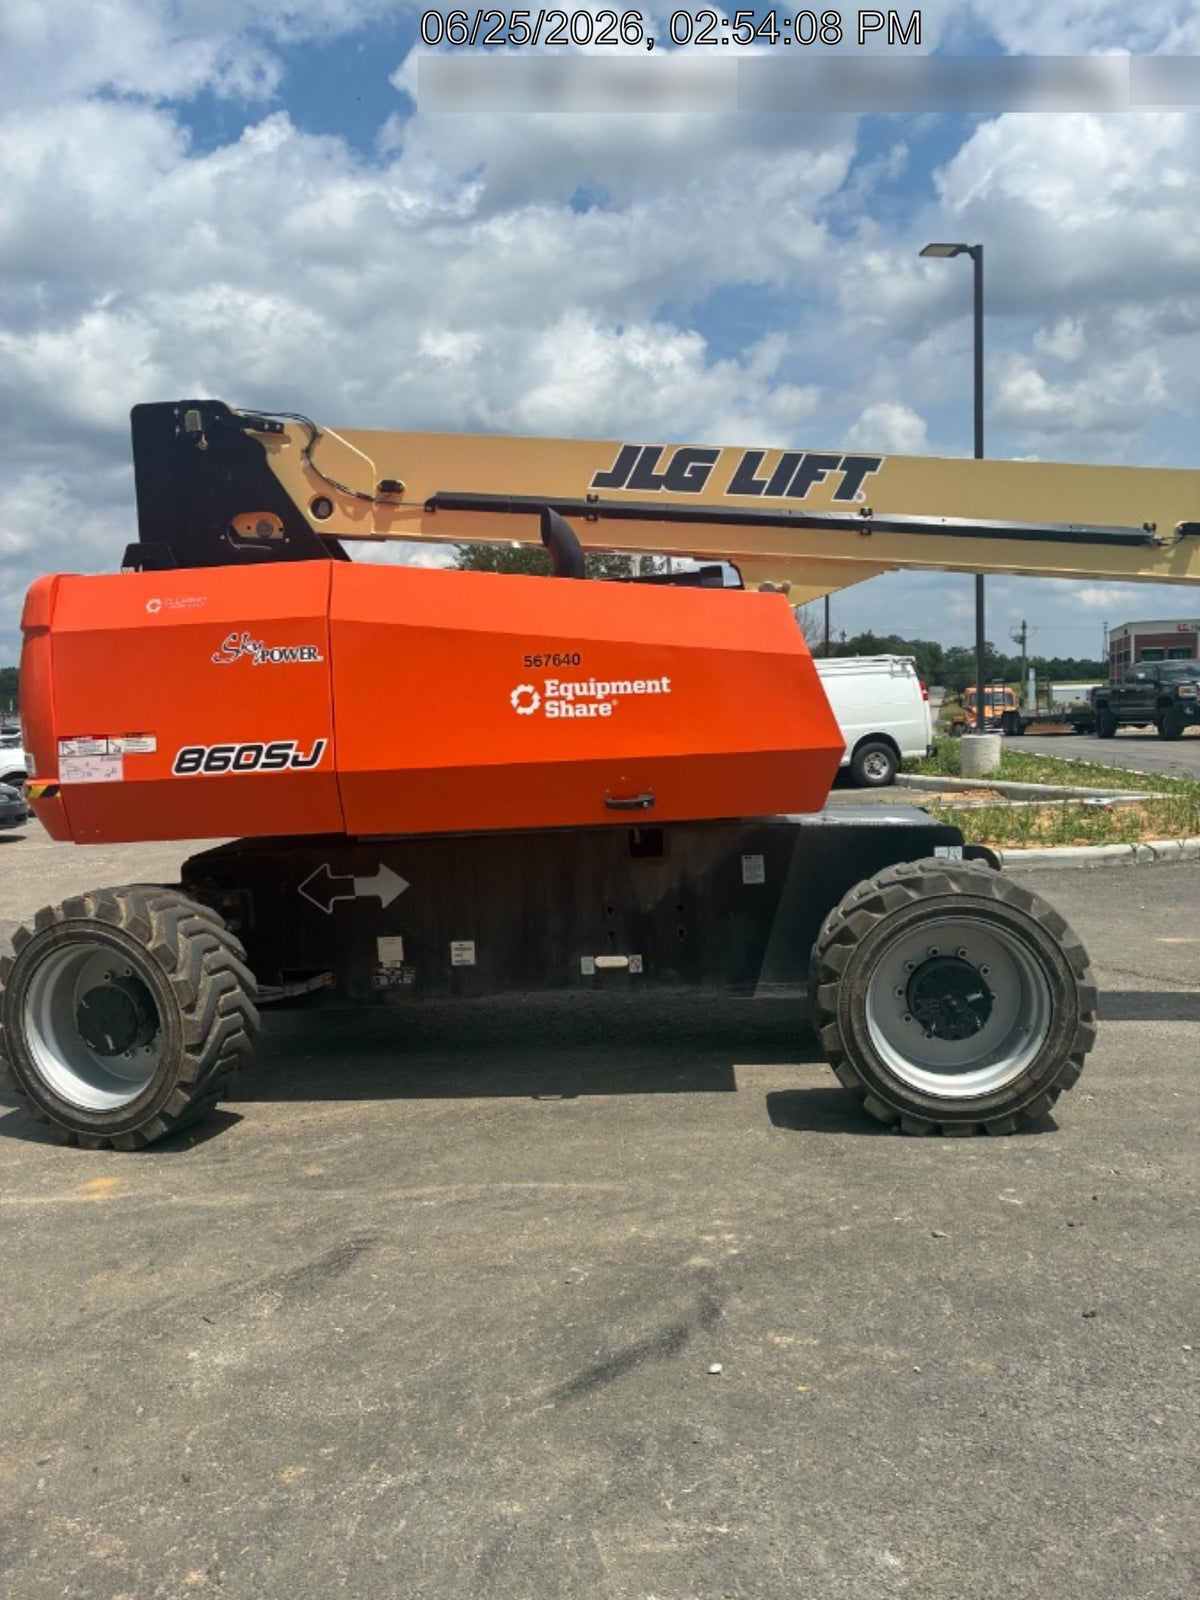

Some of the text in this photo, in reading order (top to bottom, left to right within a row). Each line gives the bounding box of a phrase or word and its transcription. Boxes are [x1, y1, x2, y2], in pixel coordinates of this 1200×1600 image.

[588, 444, 886, 502] JLG LIFT
[524, 653, 581, 667] 567640
[544, 676, 671, 700] Equipment
[545, 700, 612, 718] Share
[172, 738, 328, 776] 860SJ
